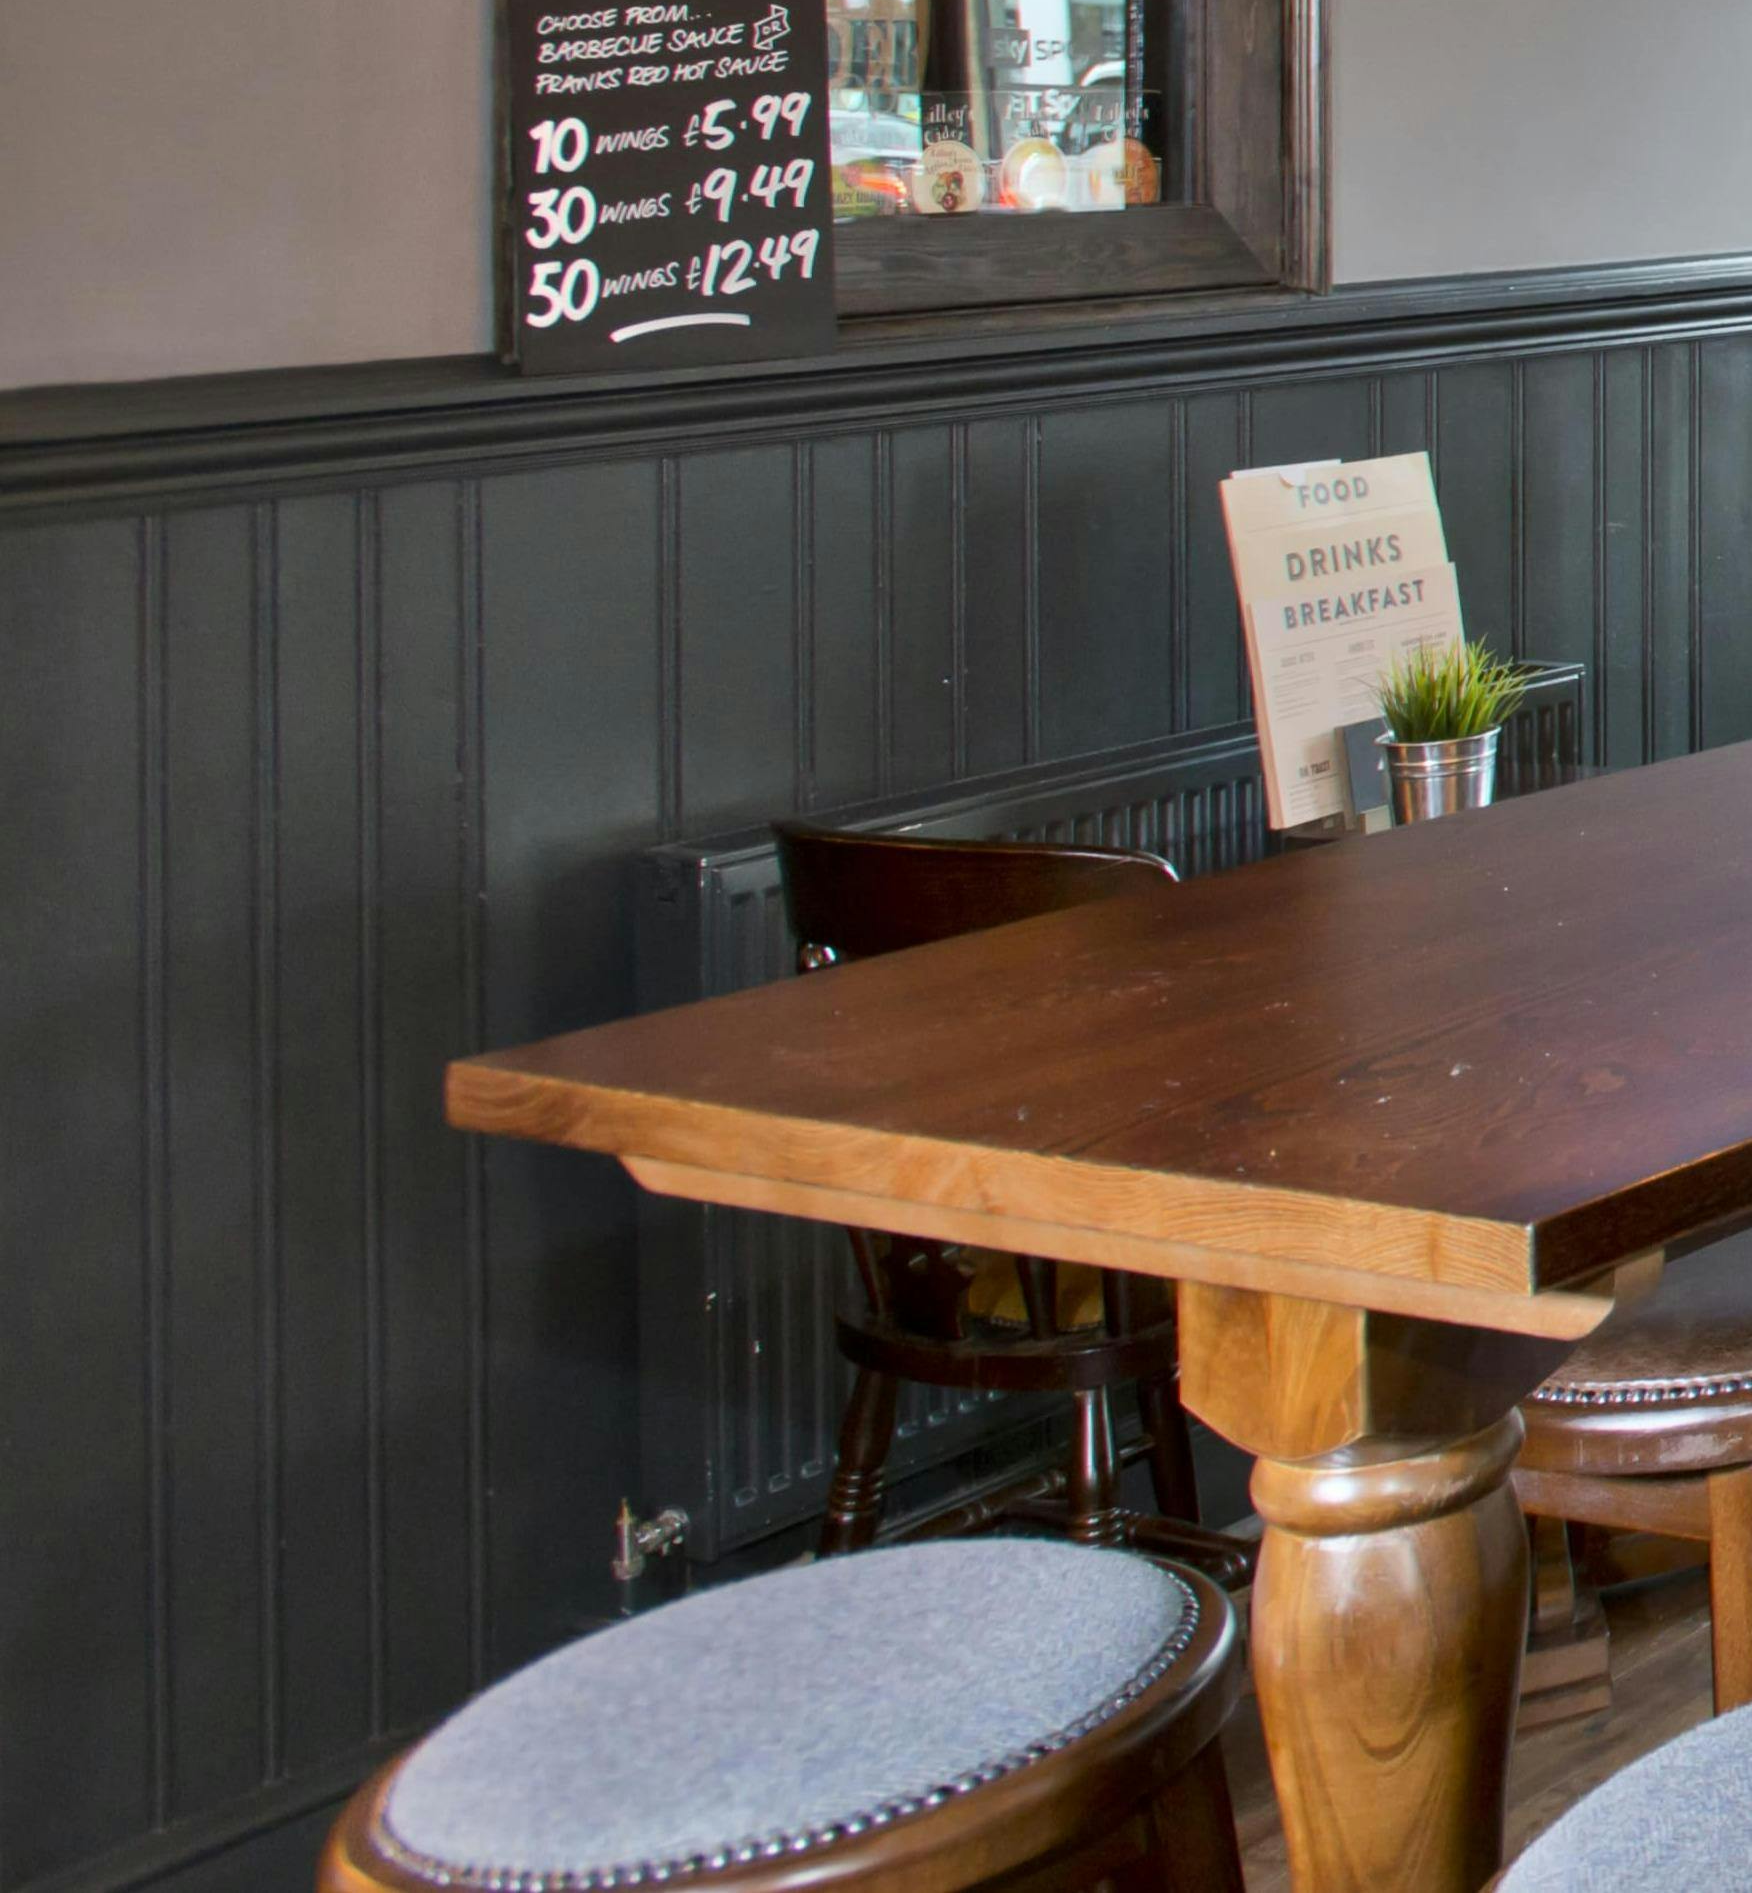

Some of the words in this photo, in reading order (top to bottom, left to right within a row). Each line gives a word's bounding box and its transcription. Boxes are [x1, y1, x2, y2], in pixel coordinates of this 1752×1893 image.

[537, 9, 618, 35] CHOOSE
[538, 33, 663, 63] BARBECUE
[667, 23, 745, 52] SAUCE
[536, 67, 623, 94] FRANKS
[627, 65, 670, 86] RED
[673, 59, 714, 83] HOT
[714, 50, 789, 79] SAUCE
[529, 117, 590, 174] 10
[595, 125, 670, 154] WINGS
[526, 186, 597, 249] 30
[599, 193, 672, 224] WINGS
[526, 258, 599, 328] 50
[602, 262, 680, 298] WINGS
[1297, 475, 1370, 509] FOOD
[1285, 533, 1404, 583] DRINKS
[1283, 578, 1426, 631] BREAKFAST
